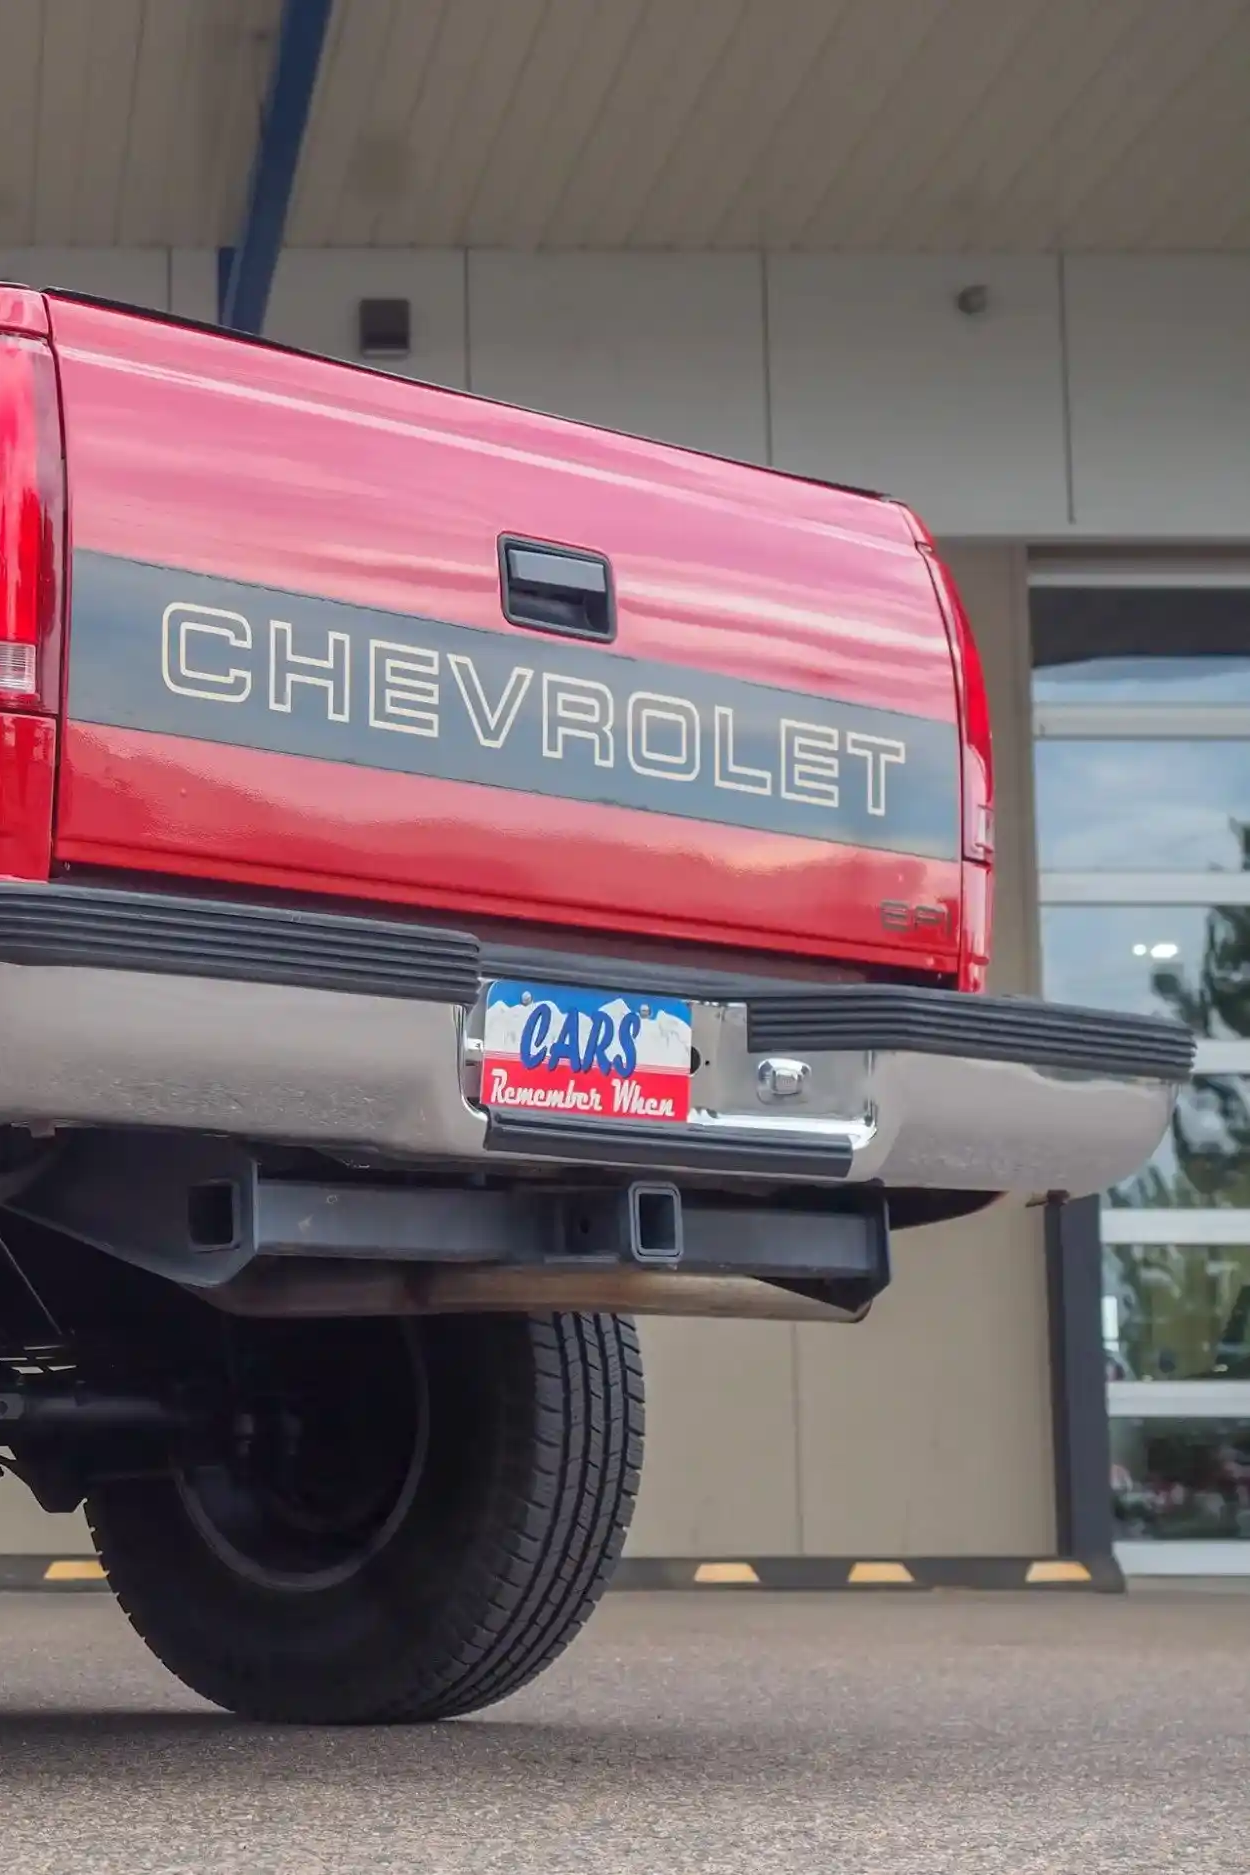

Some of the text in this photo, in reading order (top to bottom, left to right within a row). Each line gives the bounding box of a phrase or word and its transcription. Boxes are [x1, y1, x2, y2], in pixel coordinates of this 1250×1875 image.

[161, 601, 906, 816] CHEVROLET
[519, 1003, 641, 1078] CARS
[490, 1069, 675, 1118] Remember When
